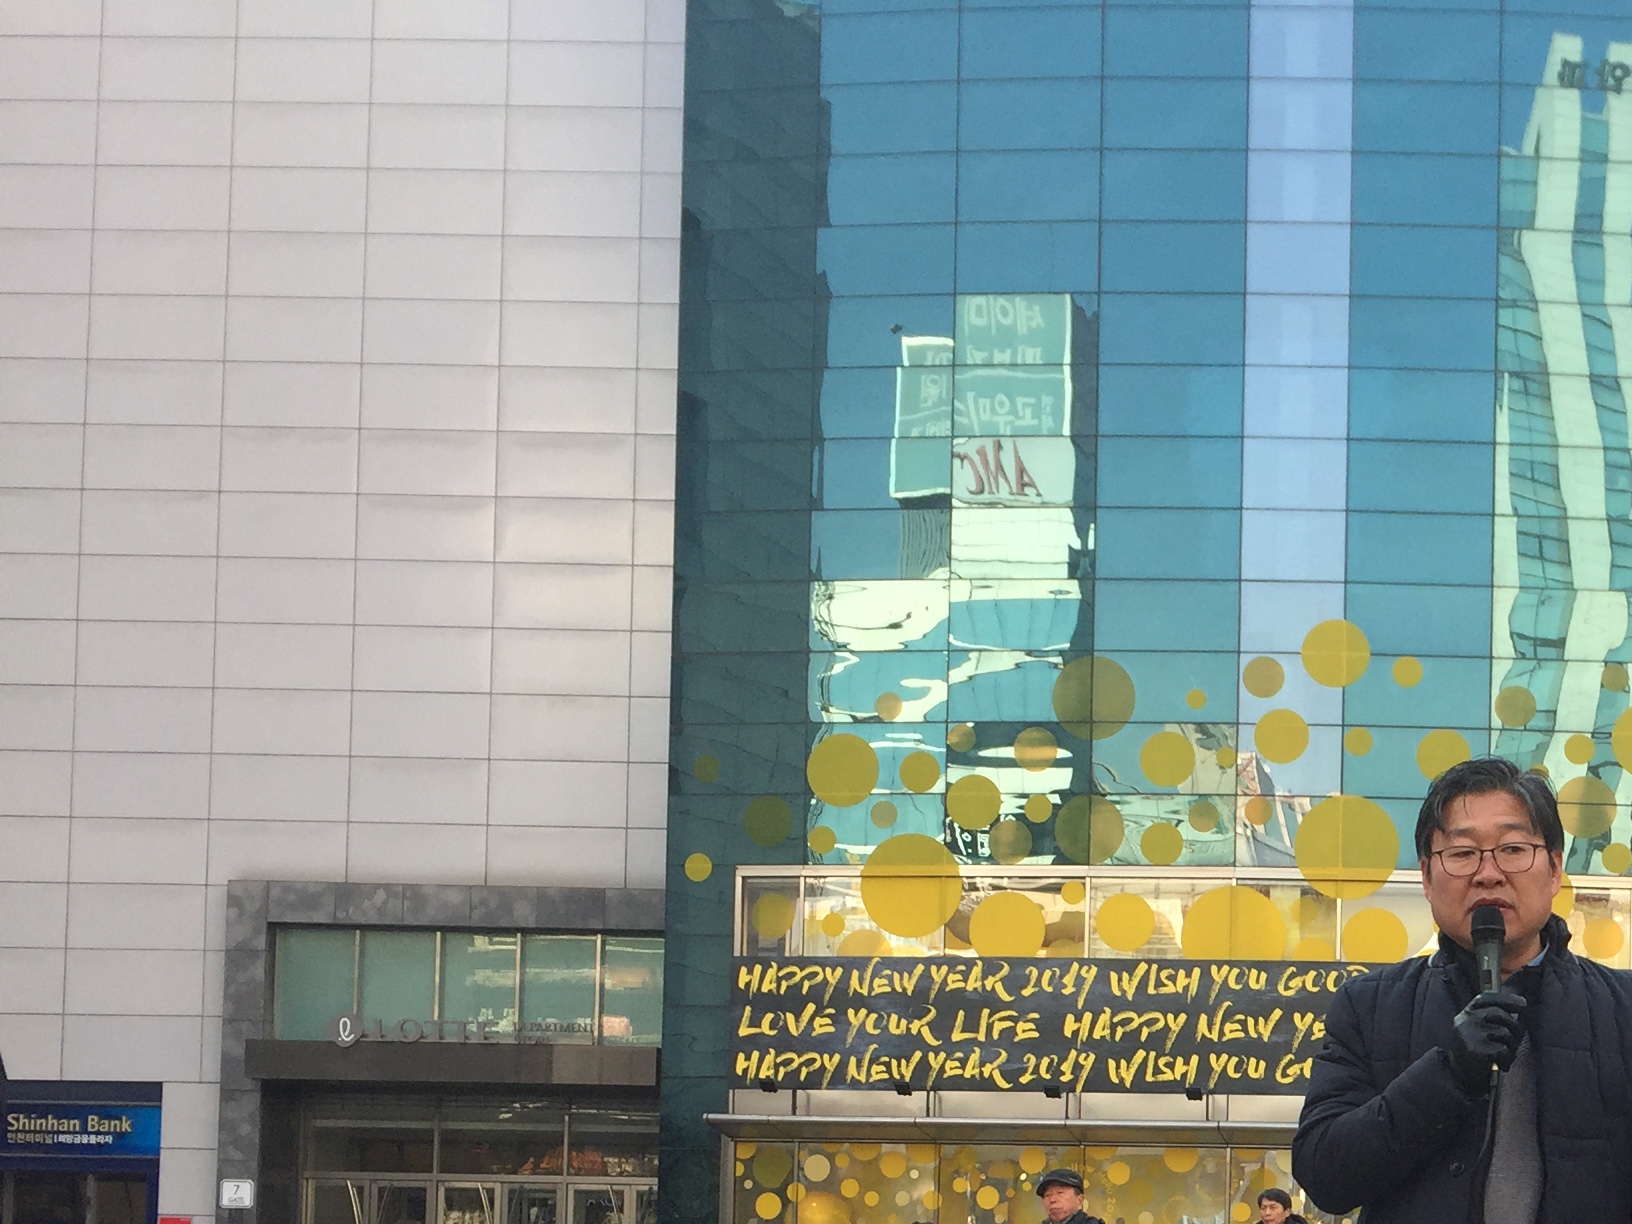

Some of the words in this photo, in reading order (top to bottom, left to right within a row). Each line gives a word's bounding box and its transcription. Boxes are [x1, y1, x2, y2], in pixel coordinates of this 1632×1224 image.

[737, 961, 843, 1005] HAPPY
[848, 957, 925, 997] NEW
[928, 960, 1016, 1003] YEAR
[1020, 961, 1098, 1009] 2019
[1109, 962, 1201, 1004] WISH
[1210, 965, 1267, 1005] YOU
[363, 1018, 495, 1042] LOTTE
[513, 1022, 596, 1034] DEPARTMENT
[737, 1002, 837, 1037] LOVE
[845, 1004, 943, 1048] YOUR
[951, 1008, 1040, 1042] LIFE
[1063, 1006, 1187, 1053] HAPPY
[1195, 1001, 1283, 1045] NEW
[1292, 1012, 1326, 1053] YE
[735, 1048, 841, 1089] HAPPY
[846, 1044, 922, 1084] NEW
[926, 1047, 1014, 1089] YEAR
[1018, 1049, 1096, 1093] 2019
[1107, 1049, 1199, 1089] WISH
[1208, 1053, 1266, 1090] YOU
[6, 1113, 81, 1132] Shinhan
[87, 1115, 133, 1132] Bank
[233, 1184, 240, 1195] 7
